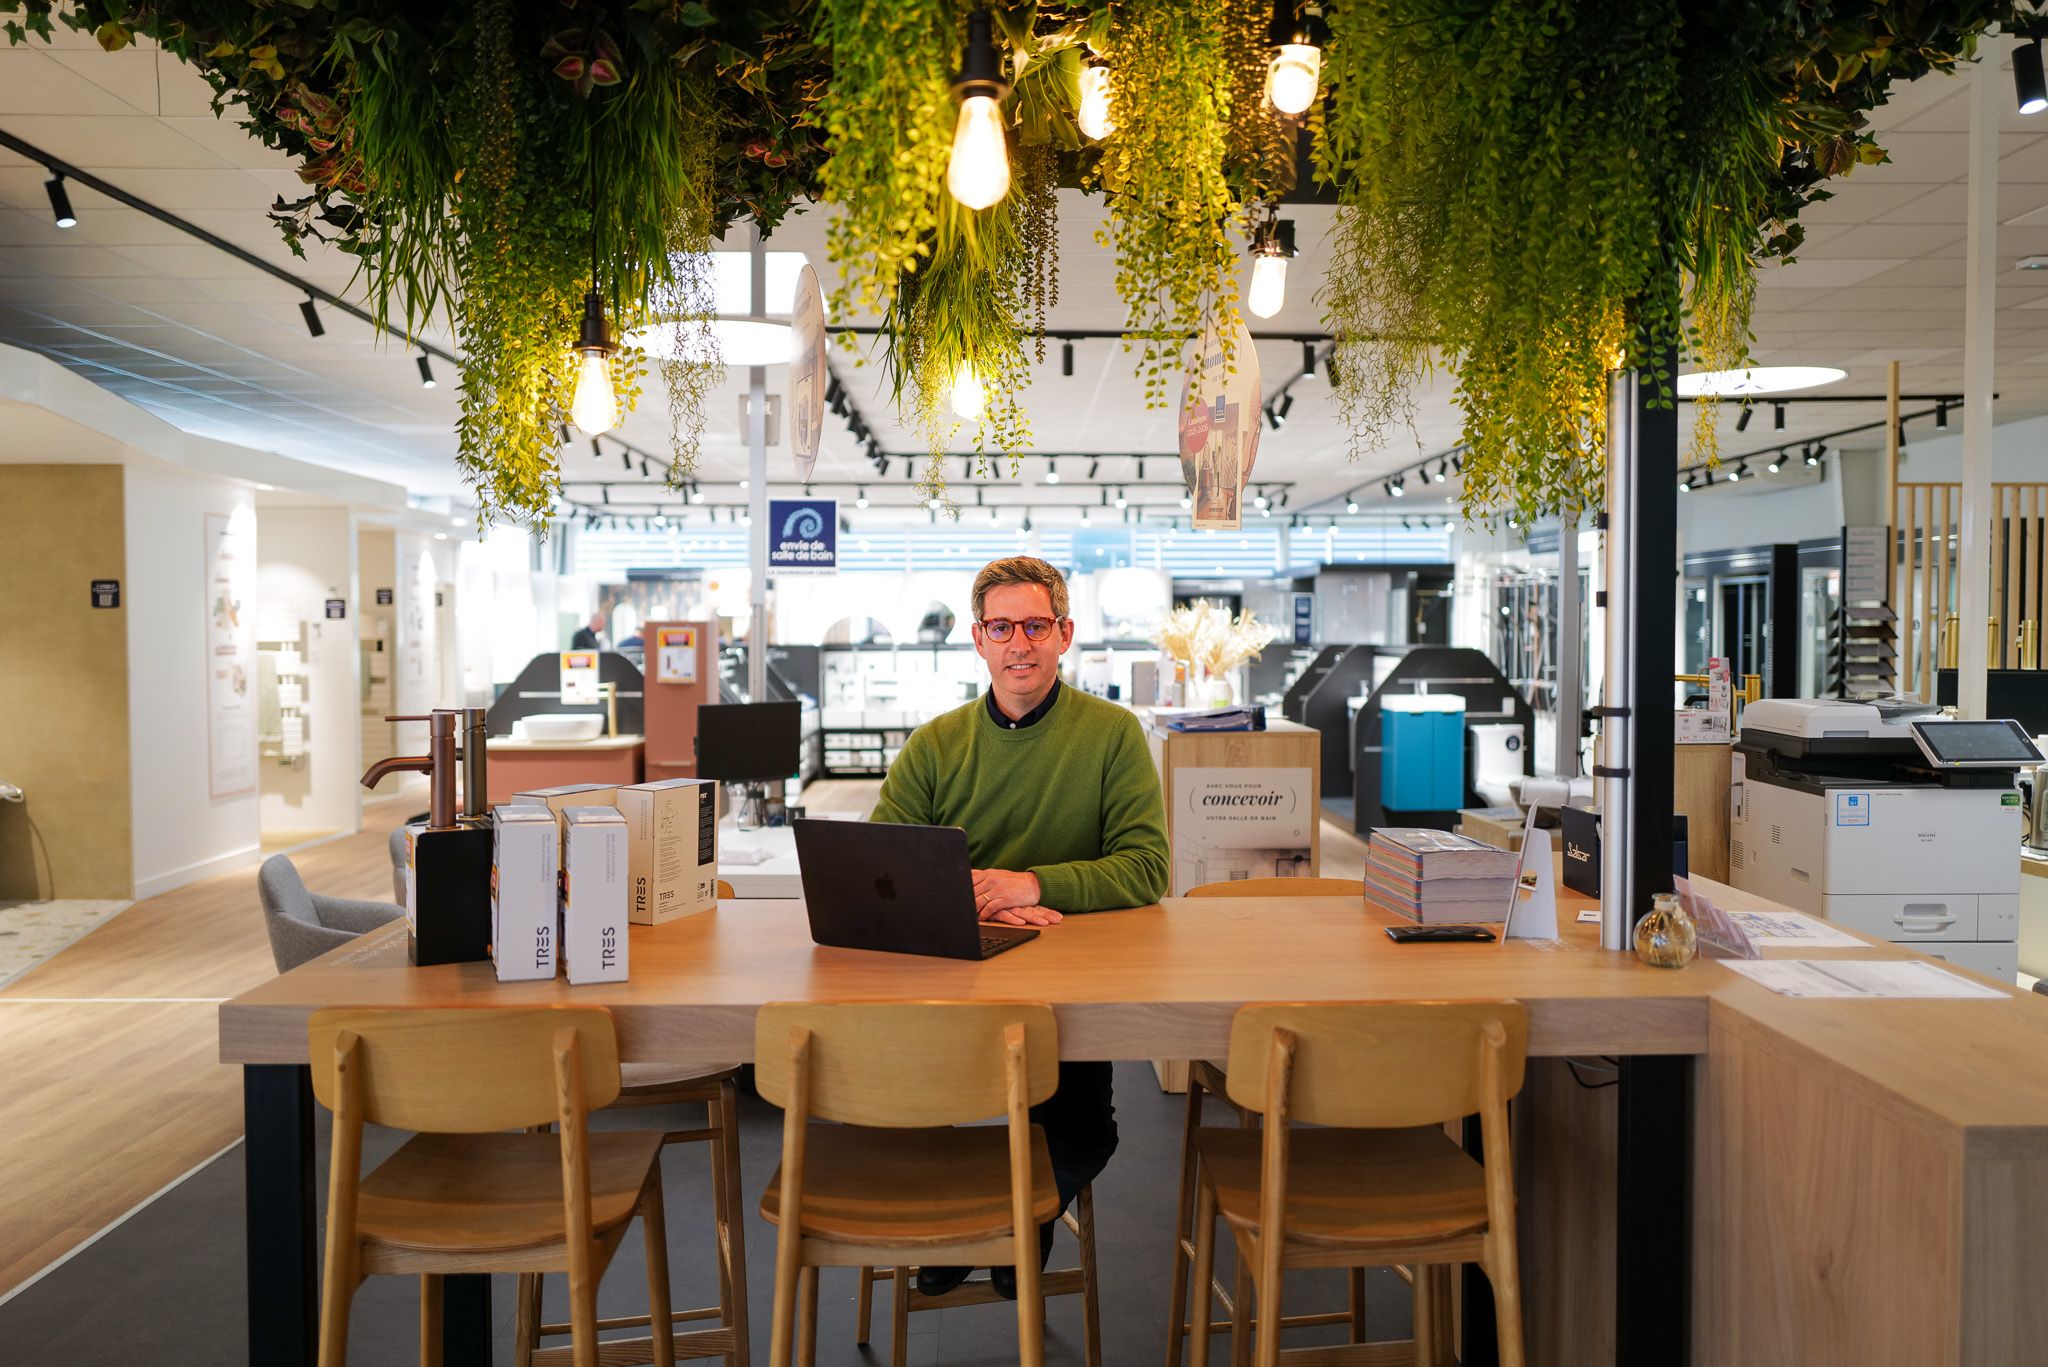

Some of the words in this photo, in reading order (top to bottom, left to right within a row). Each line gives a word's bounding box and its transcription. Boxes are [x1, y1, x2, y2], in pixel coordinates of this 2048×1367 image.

[779, 539, 809, 551] envie
[810, 539, 825, 551] de
[771, 550, 795, 561] salle
[795, 550, 809, 561] de
[810, 550, 833, 561] bain
[1202, 790, 1283, 806] concevoir
[636, 877, 646, 913] TRES
[659, 890, 675, 901] TRES
[536, 926, 549, 969] TRES
[602, 926, 615, 970] TRES
